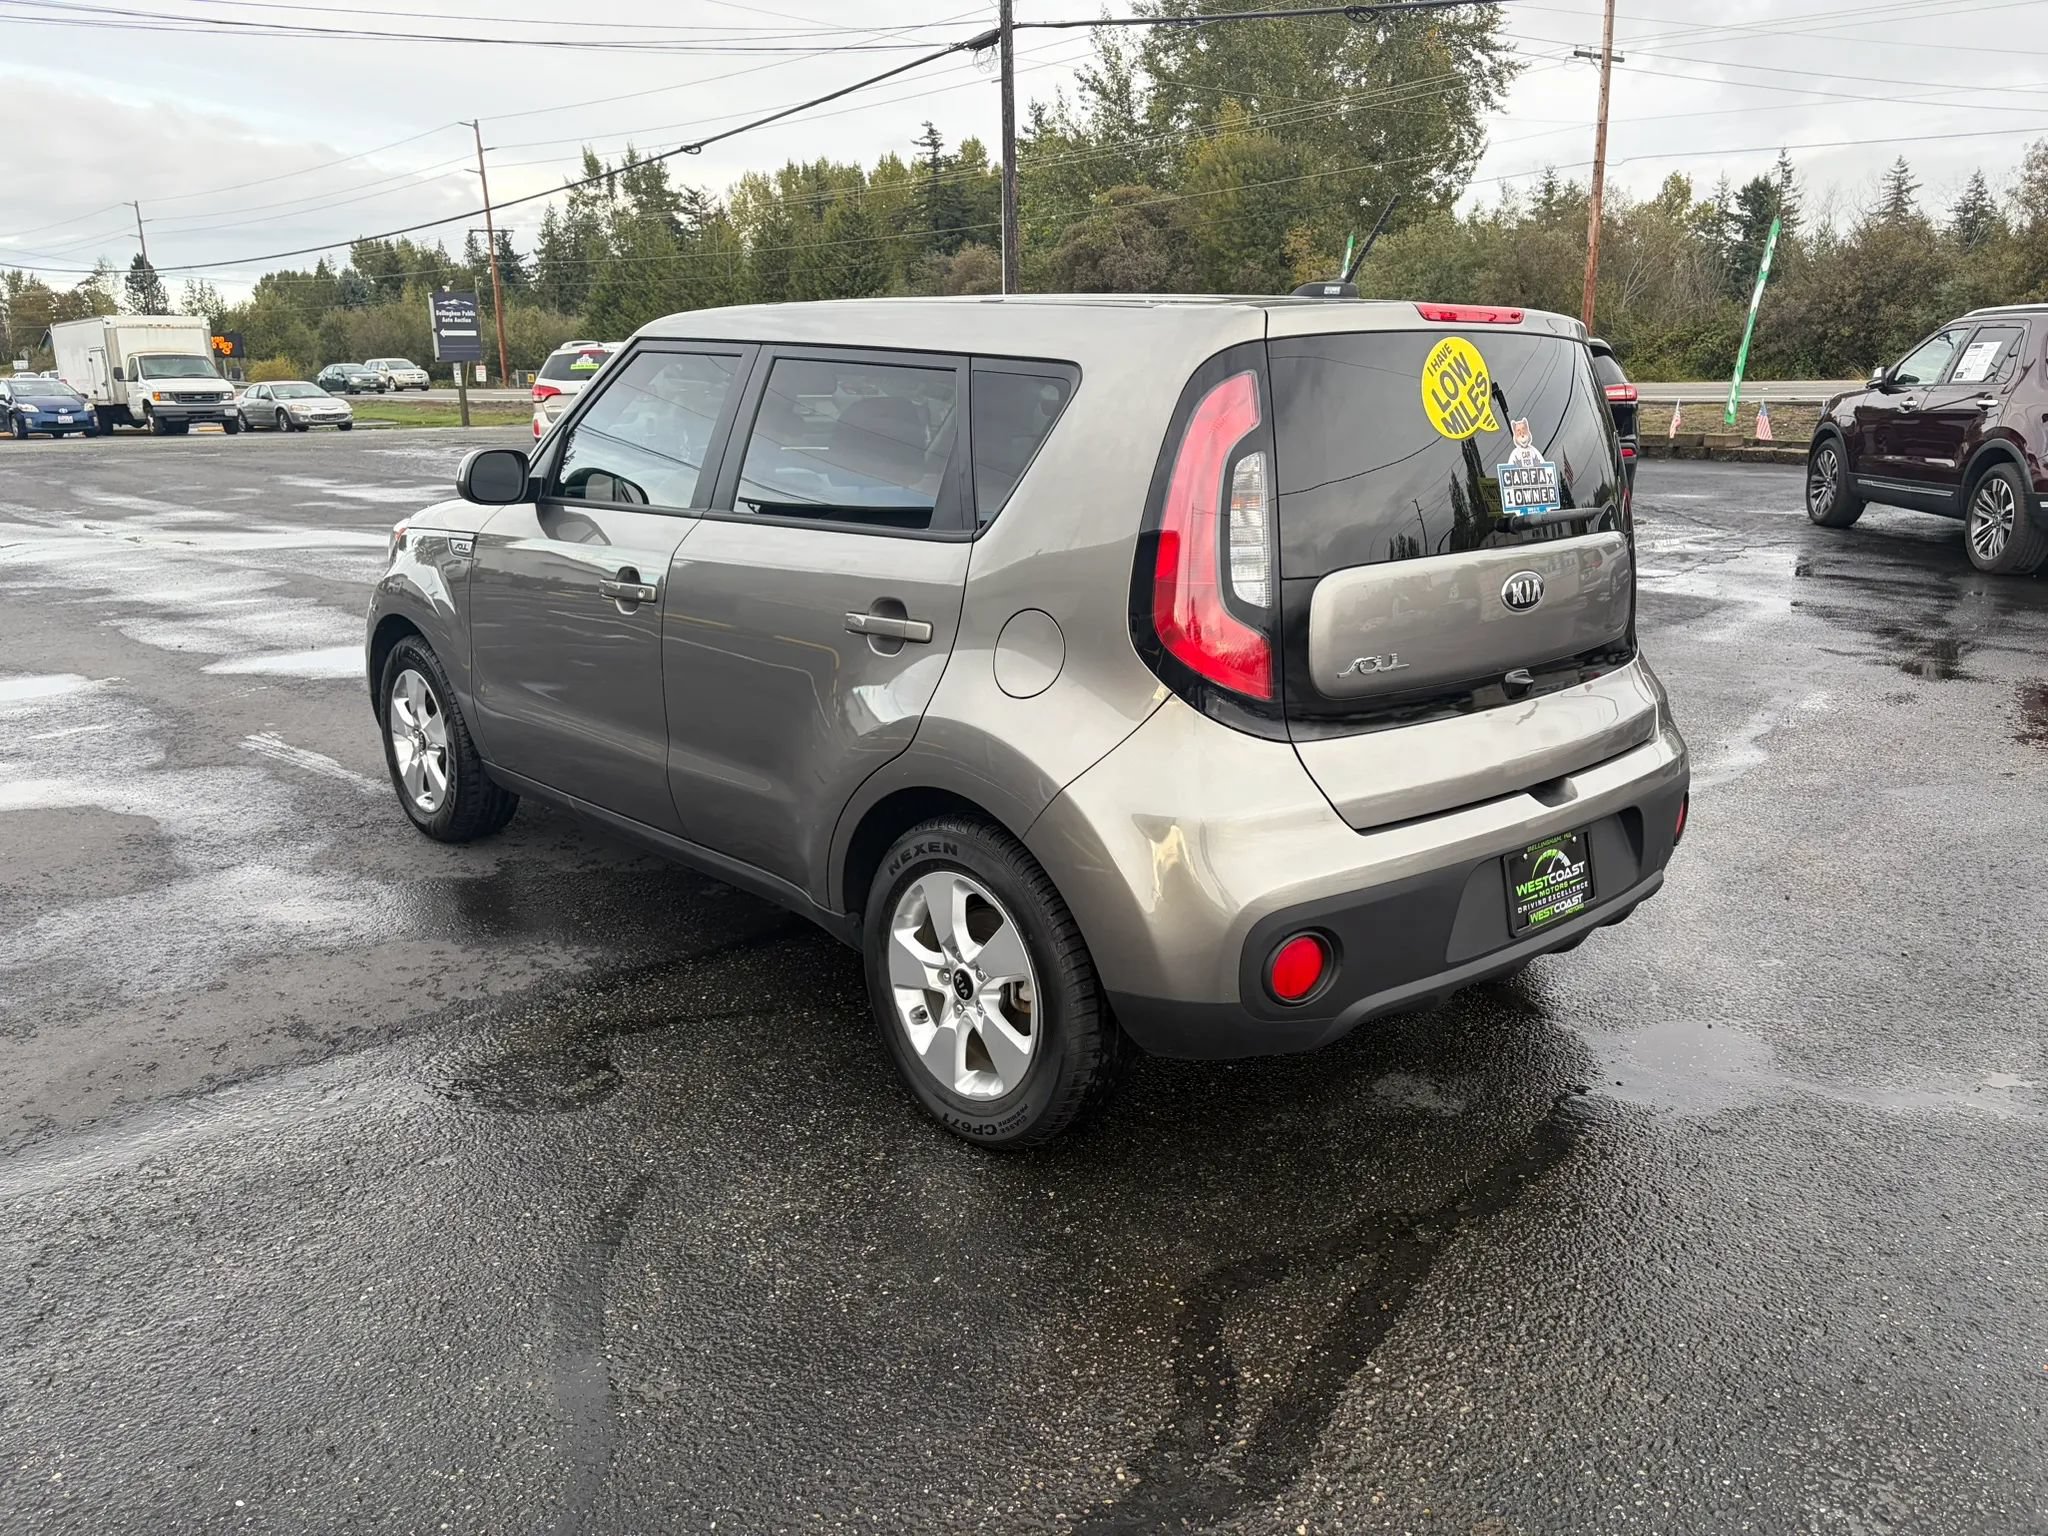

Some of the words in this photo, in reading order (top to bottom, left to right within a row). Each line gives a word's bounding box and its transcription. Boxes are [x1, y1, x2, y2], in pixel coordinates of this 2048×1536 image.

[1430, 343, 1452, 372] HAVE
[1427, 366, 1434, 377] I
[1431, 351, 1472, 413] LOW
[1440, 371, 1488, 435] MILES
[1503, 469, 1555, 485] CARFAX
[1506, 491, 1513, 504] 1
[1515, 487, 1556, 504] OWNER
[1510, 579, 1542, 605] KIA
[888, 841, 958, 876] NEXEN
[1516, 860, 1585, 897] WESTCOAST
[1539, 881, 1569, 897] MOTORS
[1517, 898, 1547, 914] DRIVING
[1548, 880, 1588, 902] EXCELLENCE
[1529, 893, 1584, 924] WESTCOAST
[955, 973, 968, 998] KIA
[942, 1112, 998, 1136] CP671
